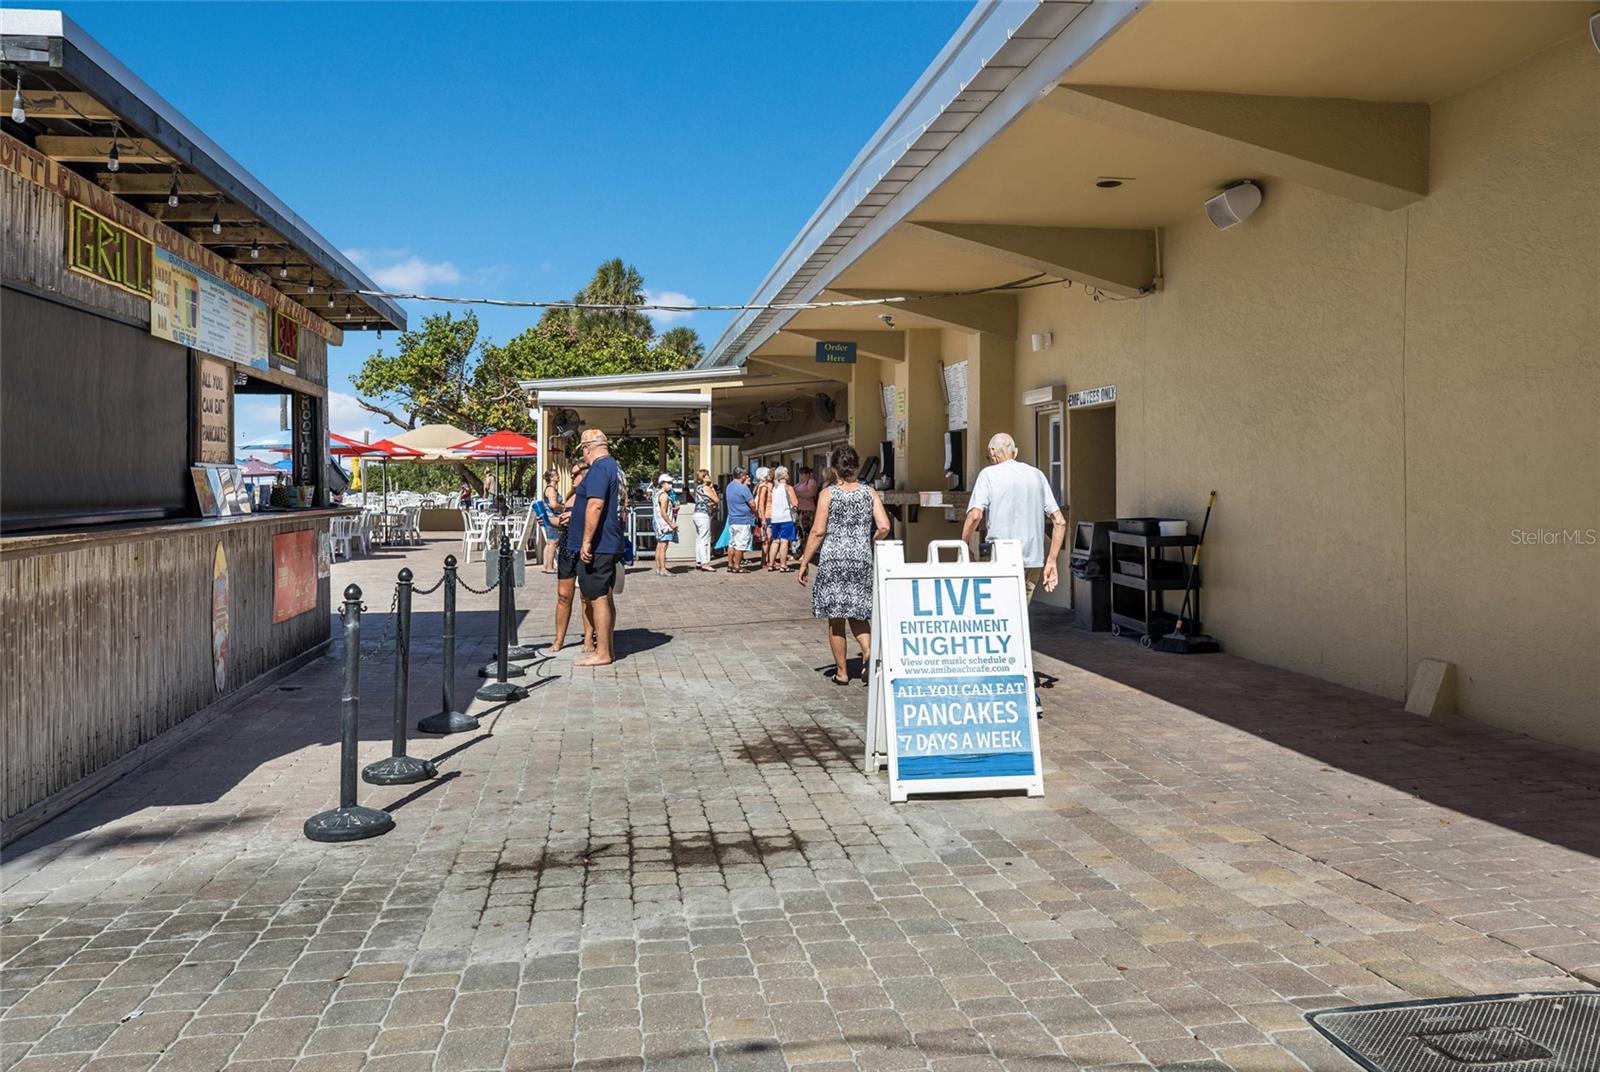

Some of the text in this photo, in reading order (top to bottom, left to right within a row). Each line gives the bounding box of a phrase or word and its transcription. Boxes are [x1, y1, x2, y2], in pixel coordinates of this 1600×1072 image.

[87, 182, 141, 230] WATER
[75, 208, 151, 295] GRILL
[824, 343, 848, 352] Order
[827, 353, 846, 362] Here
[202, 371, 224, 391] ALL YOU
[202, 397, 225, 414] CAN EAT
[1068, 386, 1115, 407] EMPLOYEES ONLY
[301, 394, 311, 486] MOOTHIE
[911, 577, 994, 616] LIVE
[900, 619, 1008, 634] ENTERTAINMENT
[902, 635, 1011, 656] NIGHTLY
[900, 658, 922, 667] View
[941, 657, 966, 666] music
[968, 656, 1006, 665] schedule
[1008, 657, 1016, 665] @
[904, 665, 1010, 675] www.amibeachcafe.com
[897, 683, 1025, 697] ALL YOU CAN EAT
[903, 700, 1019, 727] PANCAKES
[900, 730, 1022, 751] 7 DAYS A WEEK
